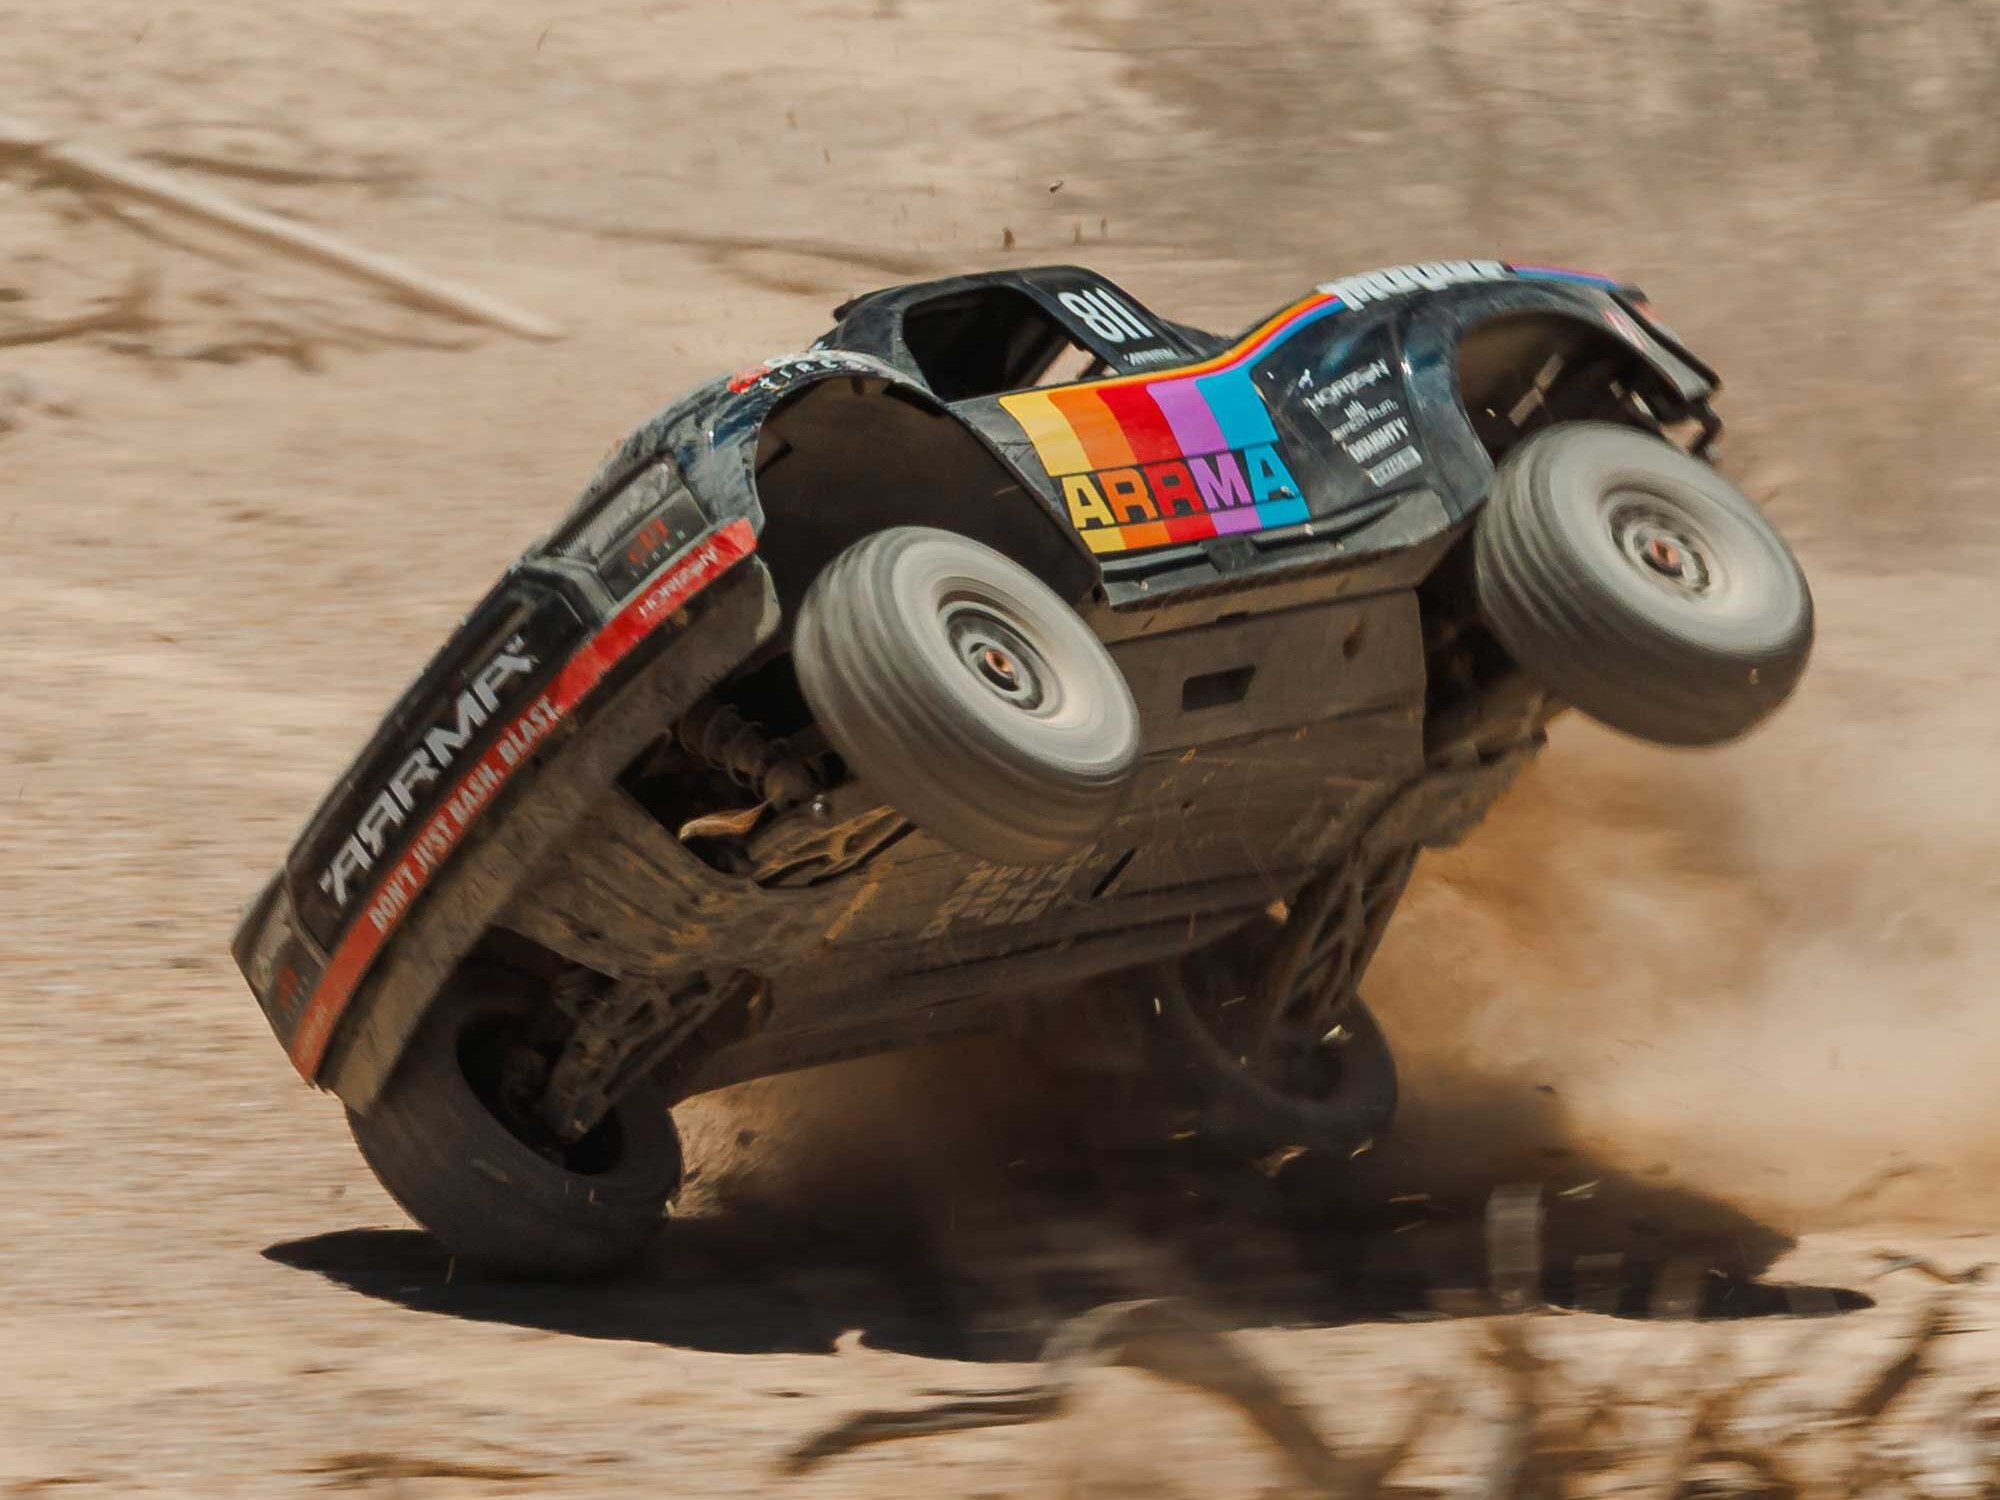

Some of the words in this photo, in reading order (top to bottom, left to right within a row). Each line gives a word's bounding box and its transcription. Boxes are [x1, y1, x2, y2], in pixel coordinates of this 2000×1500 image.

[1057, 287, 1154, 343] 811
[1060, 443, 1300, 529] ARRMA
[318, 648, 536, 906] ARRMA
[368, 864, 417, 933] DON'T
